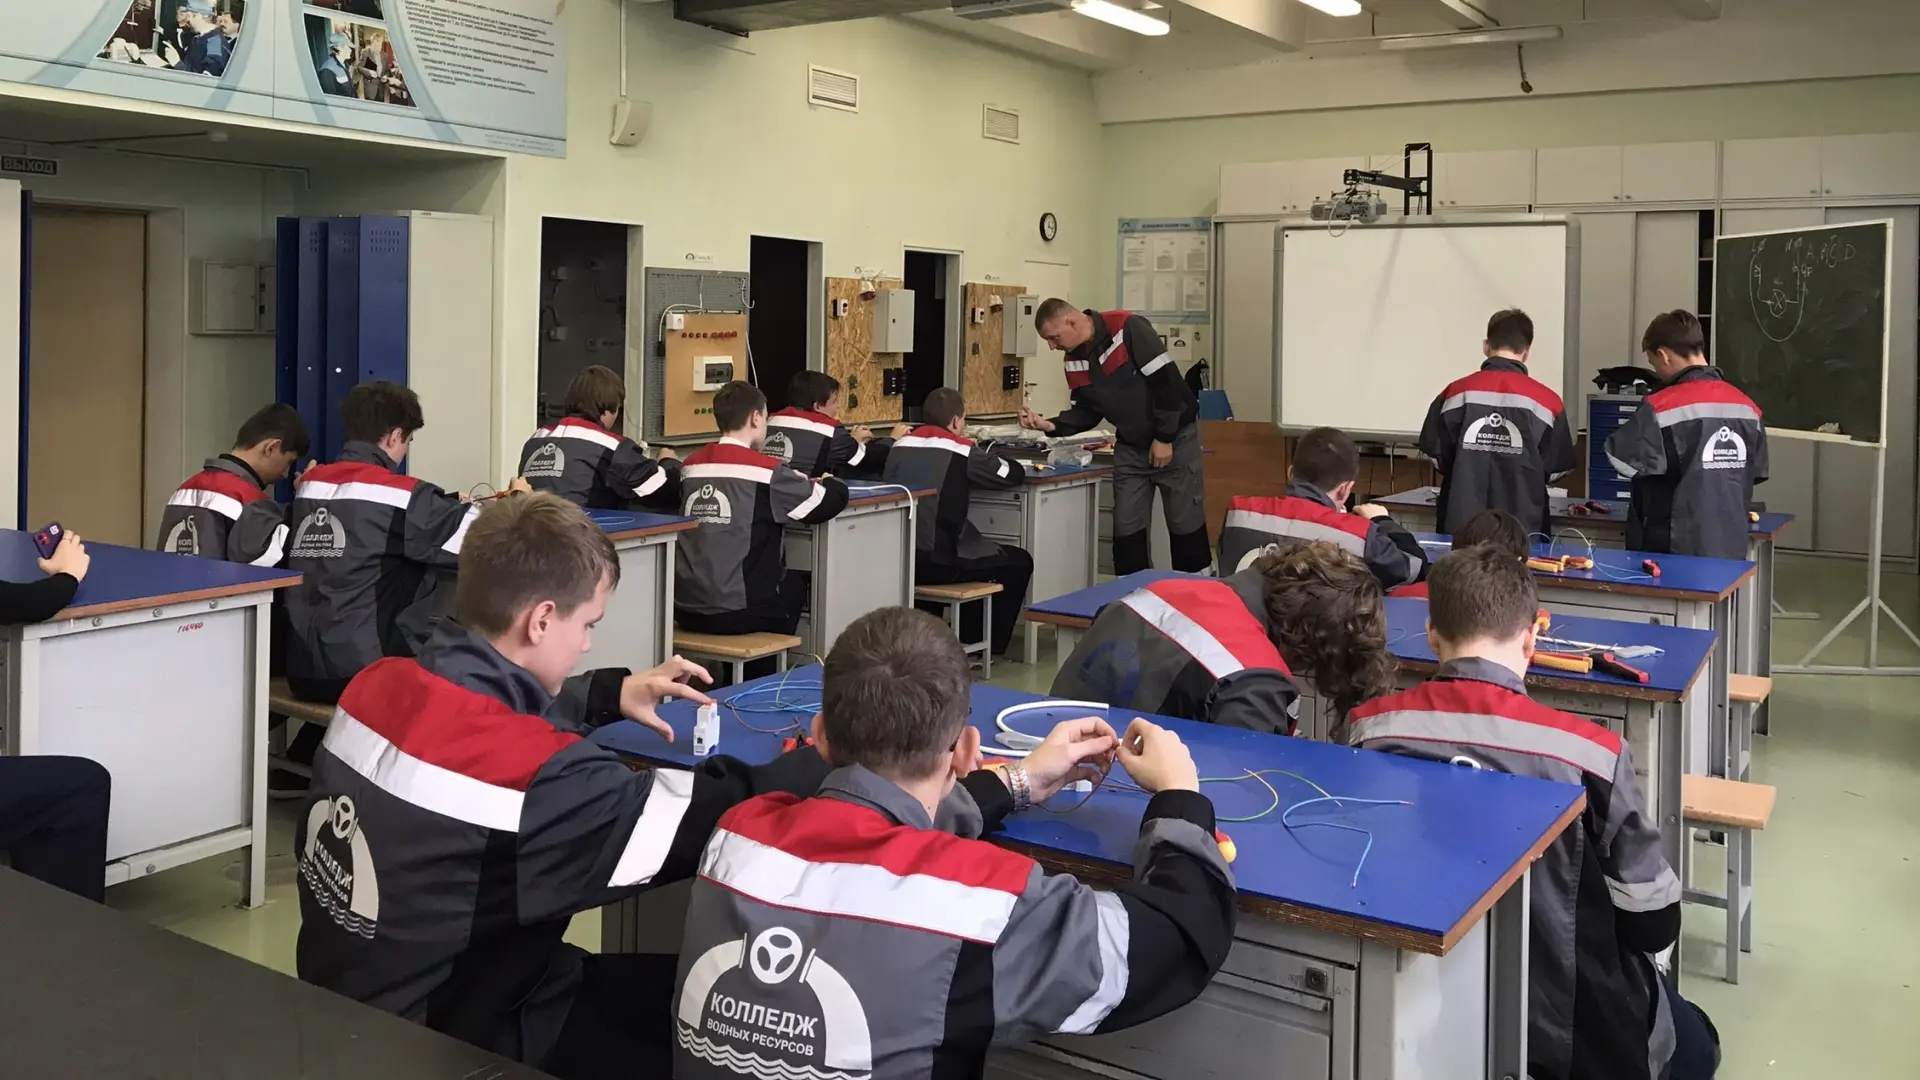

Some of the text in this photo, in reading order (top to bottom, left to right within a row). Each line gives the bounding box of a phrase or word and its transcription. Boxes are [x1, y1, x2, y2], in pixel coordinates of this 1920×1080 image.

[3, 157, 55, 173] ВЫХОД
[710, 991, 819, 1038] КОЛЛЕДЖ
[707, 1018, 814, 1056] ВОДНЫХ РЕСУРСОВ
